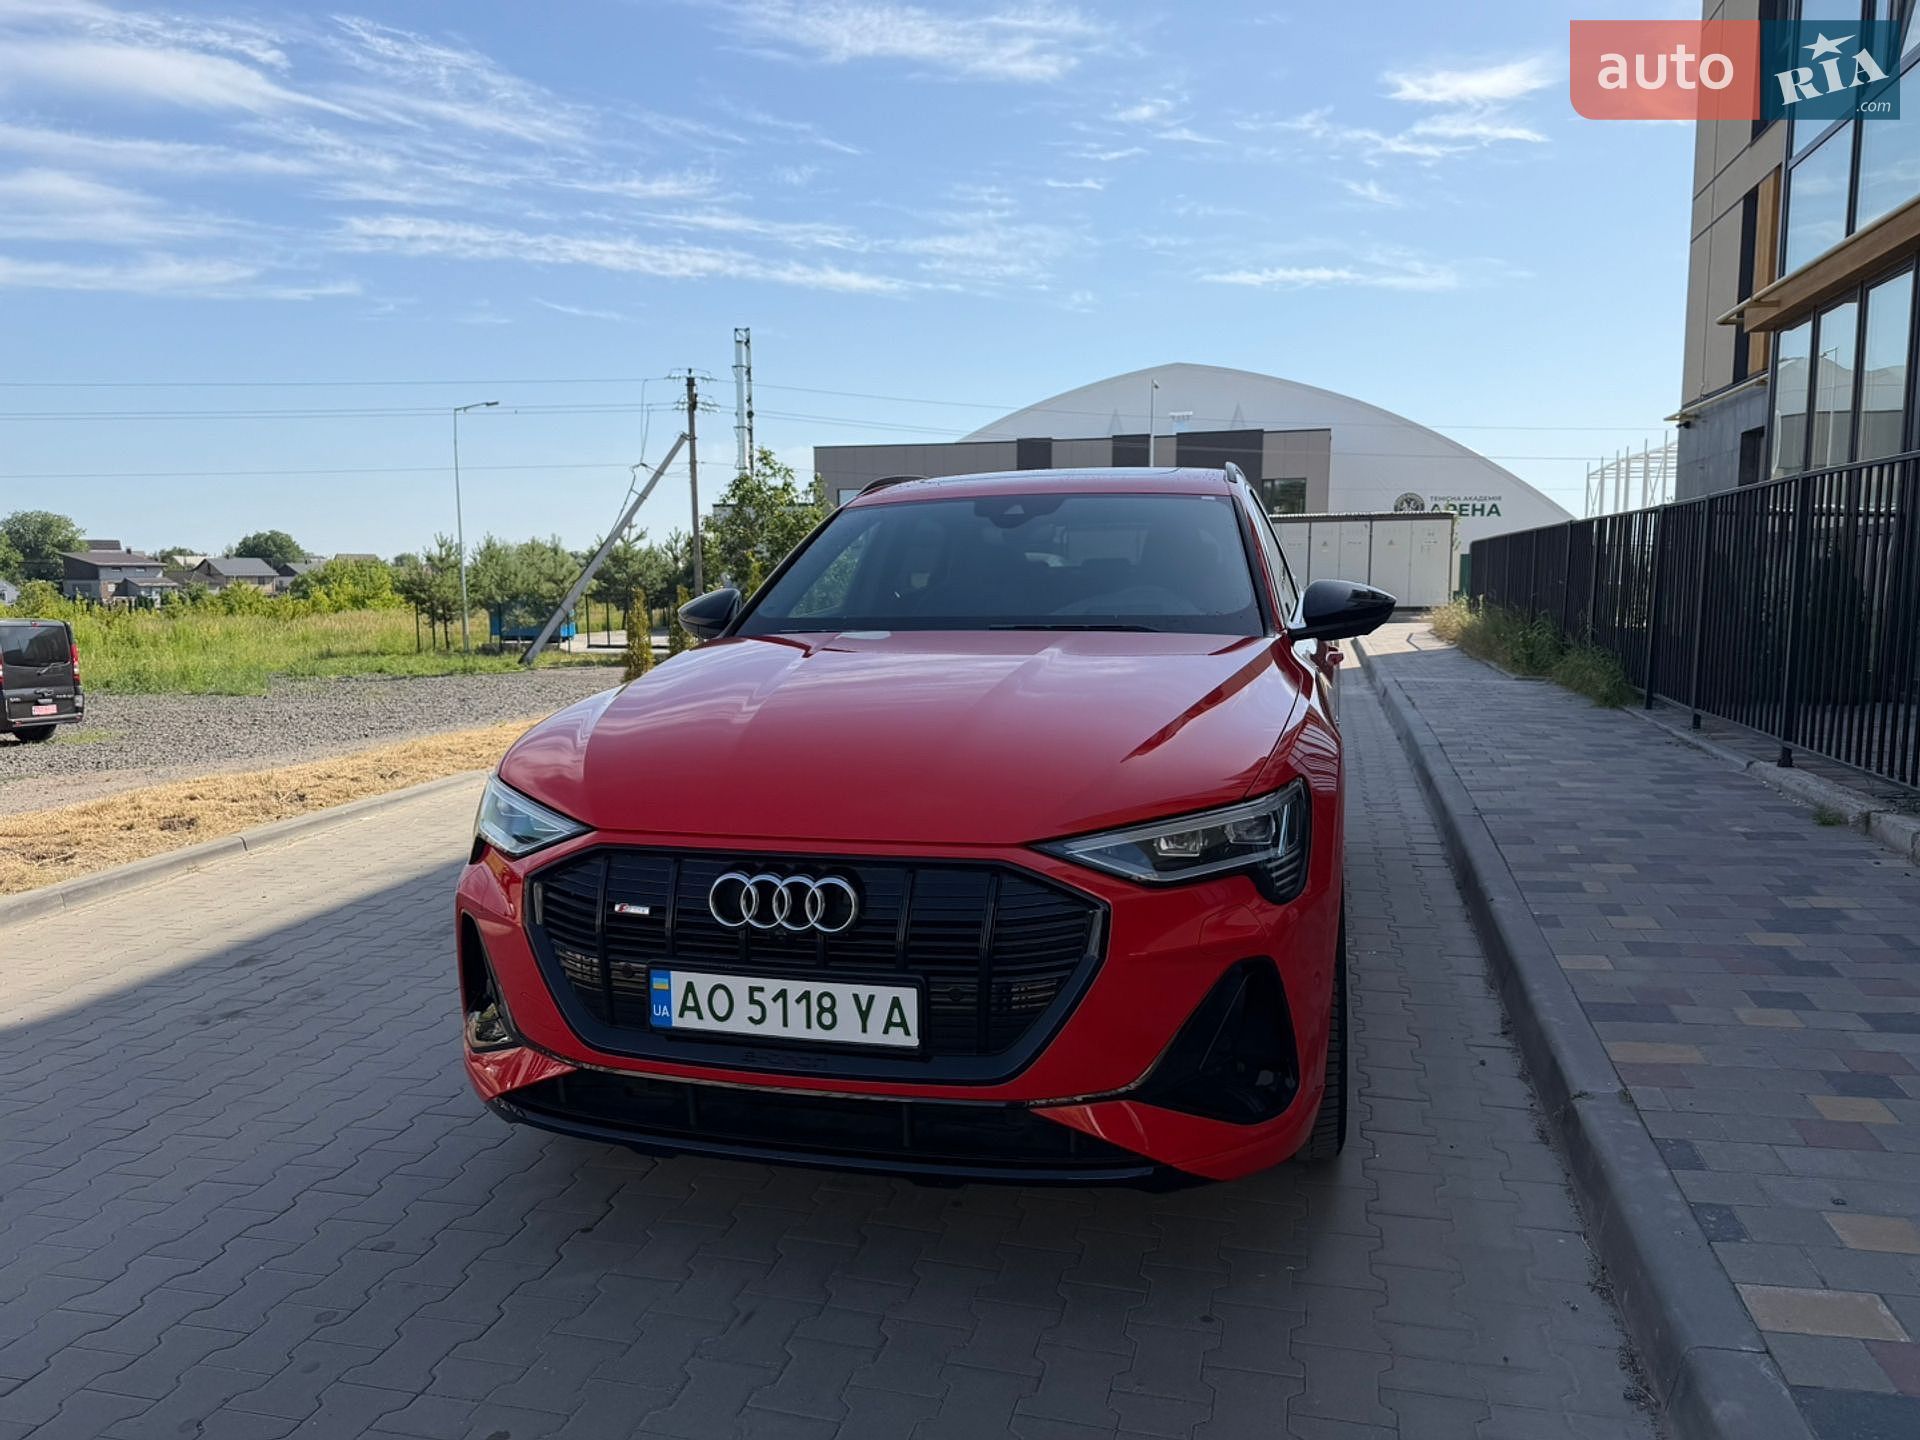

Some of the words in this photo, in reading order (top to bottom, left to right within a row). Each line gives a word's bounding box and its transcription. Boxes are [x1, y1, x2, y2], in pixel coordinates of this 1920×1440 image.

[653, 1004, 671, 1018] UA
[677, 981, 735, 1023] AO
[747, 985, 838, 1031] 5118
[852, 993, 912, 1037] YA
